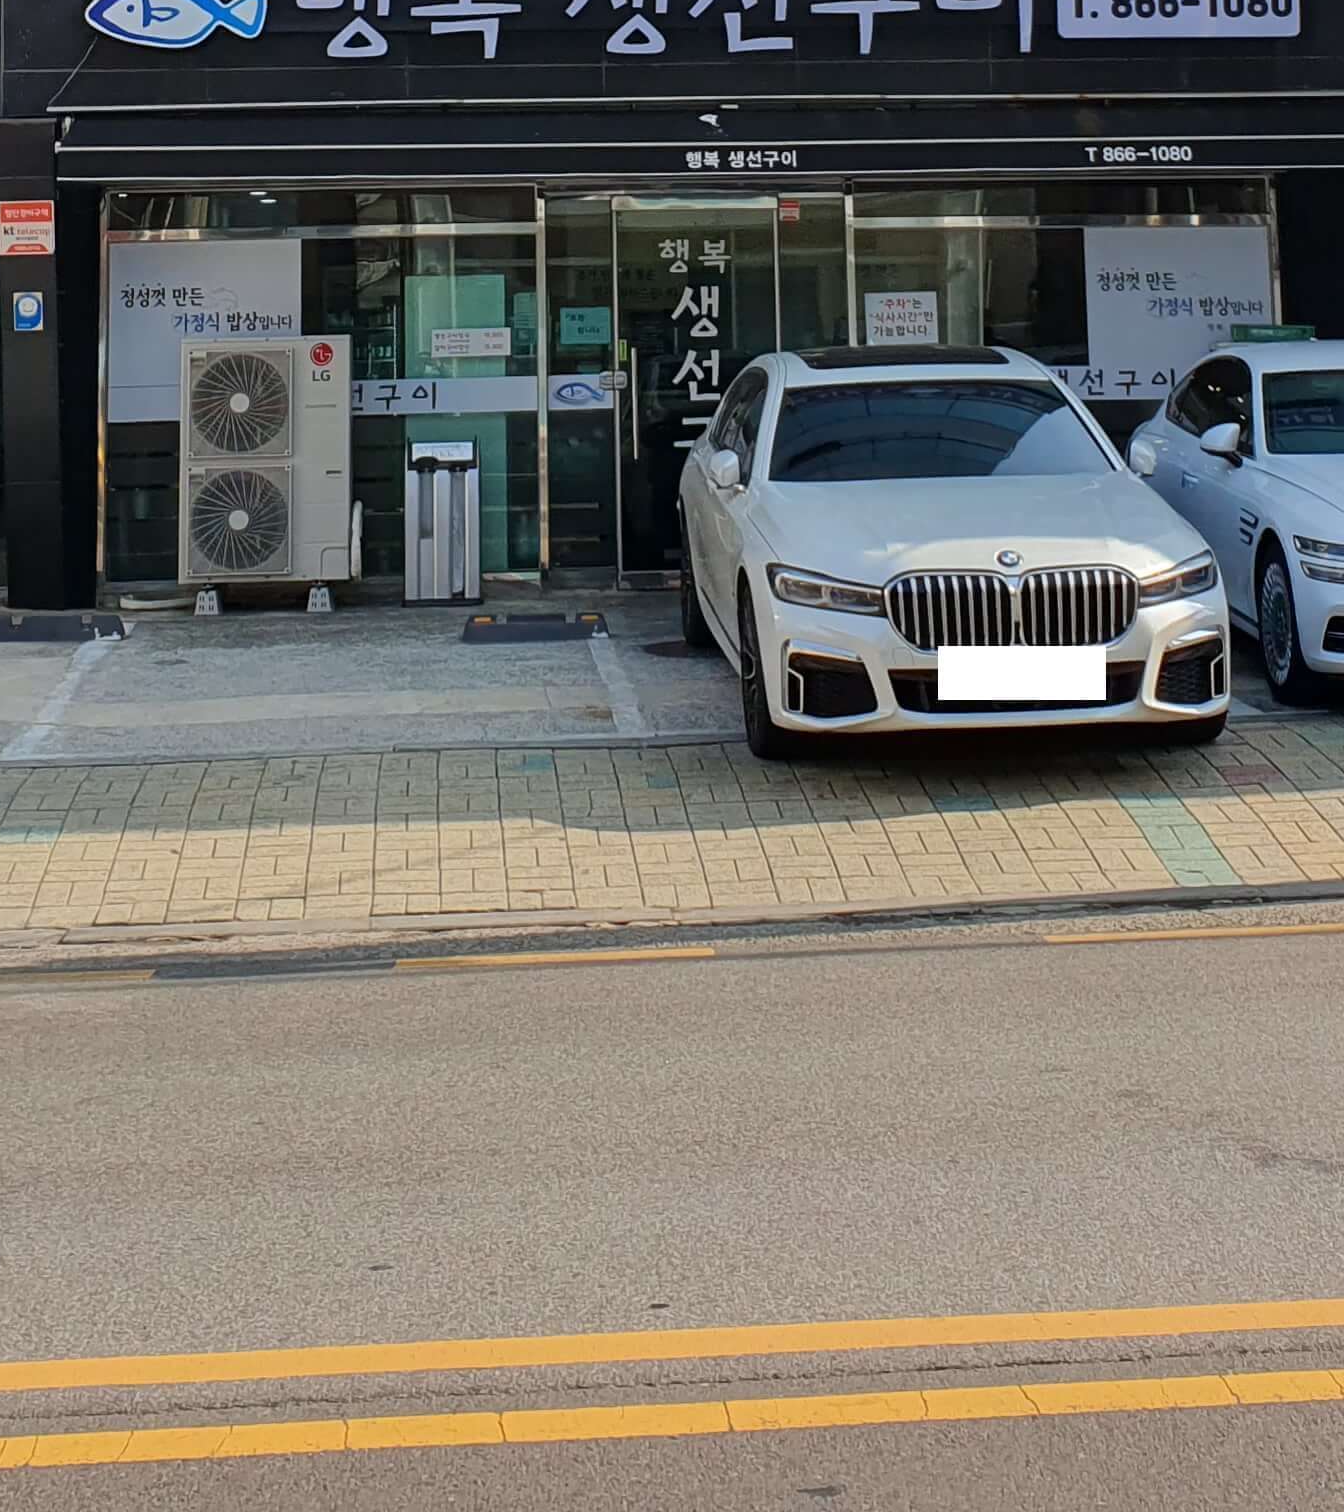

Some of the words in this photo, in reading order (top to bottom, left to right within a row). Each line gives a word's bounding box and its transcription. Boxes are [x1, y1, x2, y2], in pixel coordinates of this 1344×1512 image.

[685, 150, 720, 169] 행복
[727, 149, 798, 169] 생선구이
[1085, 146, 1096, 162] T
[1102, 145, 1193, 163] 866-1080
[659, 239, 732, 274] 행복
[172, 287, 205, 307] 만든
[174, 312, 220, 334] 가정식
[227, 311, 292, 333] 밥상입니다
[312, 370, 331, 382] LG
